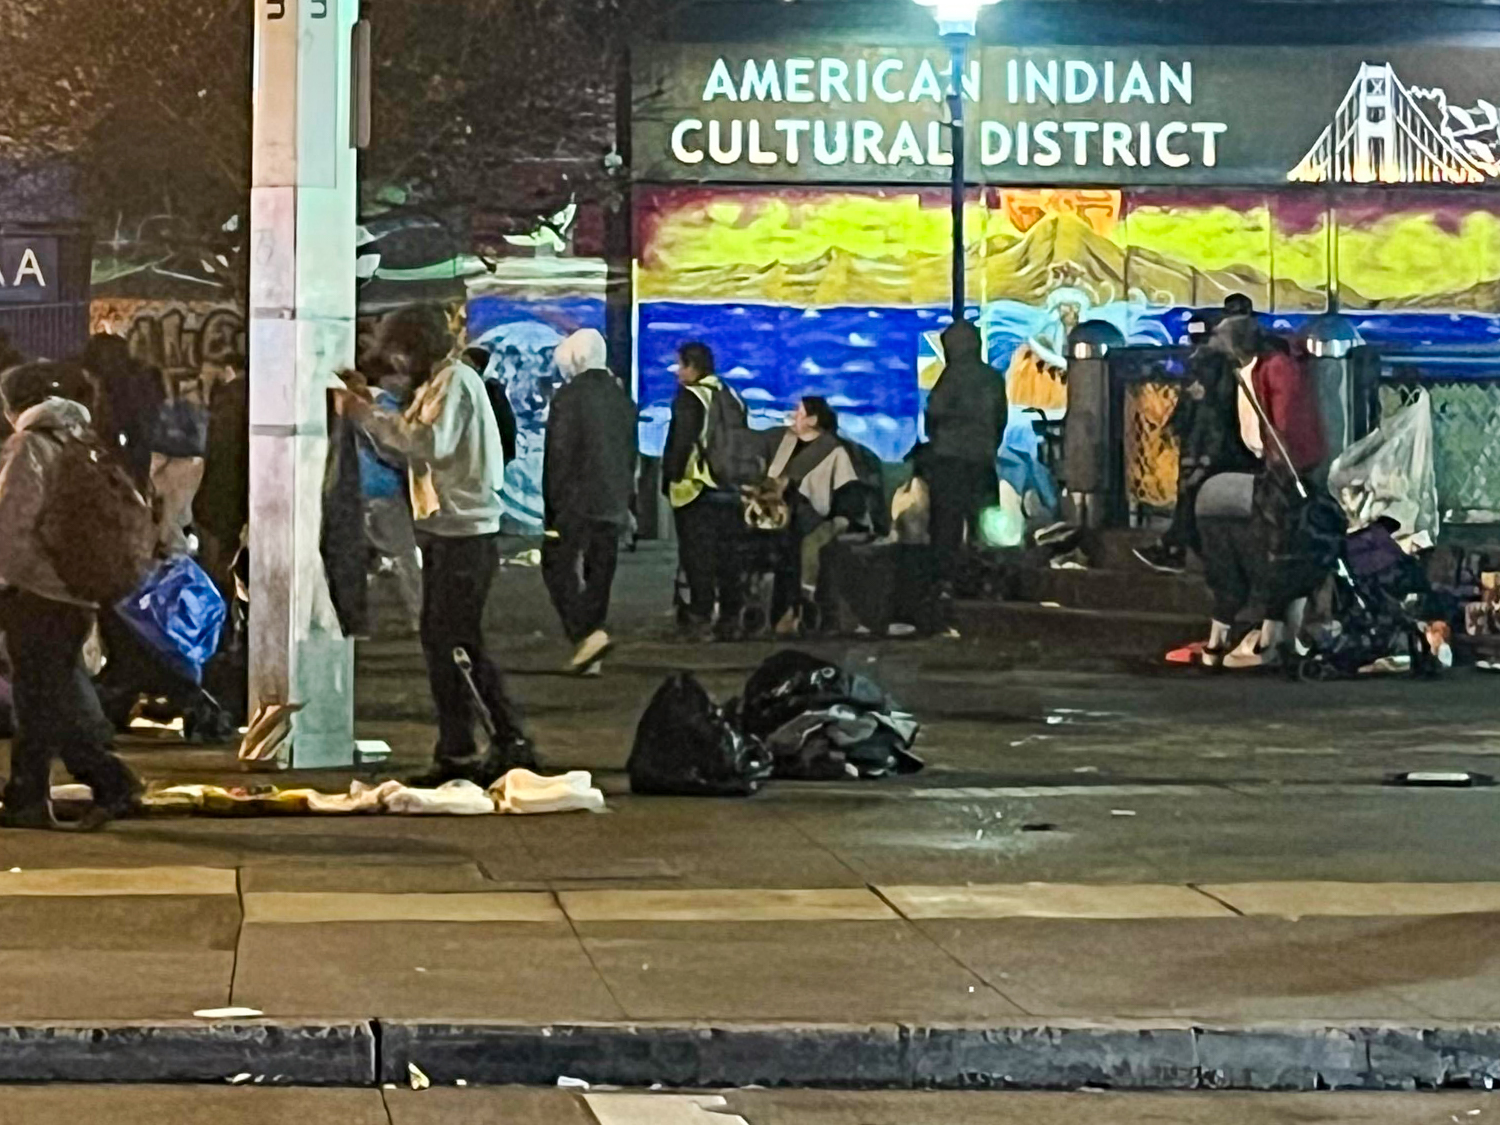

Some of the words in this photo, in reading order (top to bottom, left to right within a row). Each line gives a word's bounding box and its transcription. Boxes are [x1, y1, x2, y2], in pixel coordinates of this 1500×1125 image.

[701, 58, 981, 104] AMERICAN
[1006, 59, 1193, 105] INDIAN
[670, 118, 955, 167] CULTURAL
[980, 120, 1228, 168] DISTRICT
